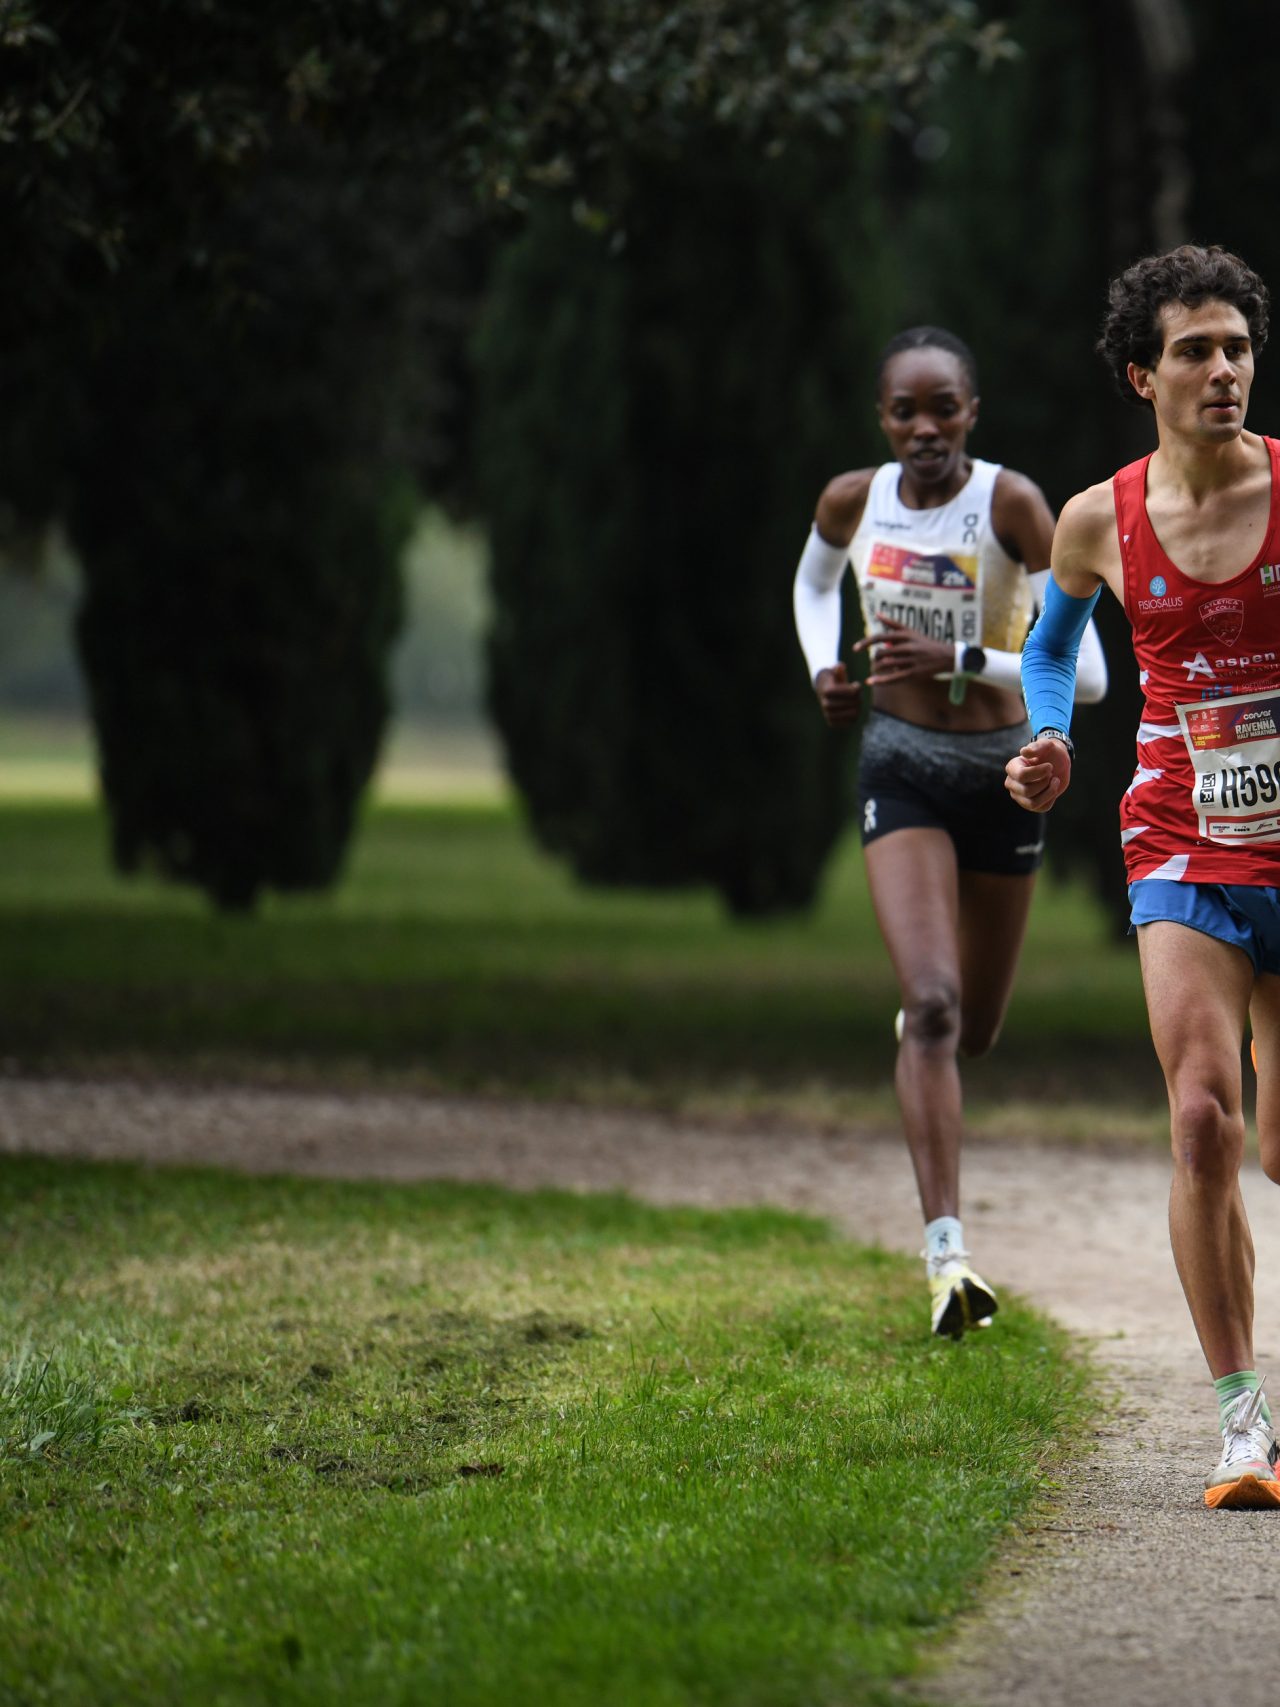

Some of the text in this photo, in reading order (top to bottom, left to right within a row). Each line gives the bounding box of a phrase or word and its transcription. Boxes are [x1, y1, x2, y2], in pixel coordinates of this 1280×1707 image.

[1138, 597, 1184, 610] FISIOSALUS
[1204, 599, 1240, 610] ATLETICA
[1215, 651, 1276, 668] aspen
[1235, 719, 1277, 735] RAVENNA
[1250, 728, 1278, 738] MARATHON
